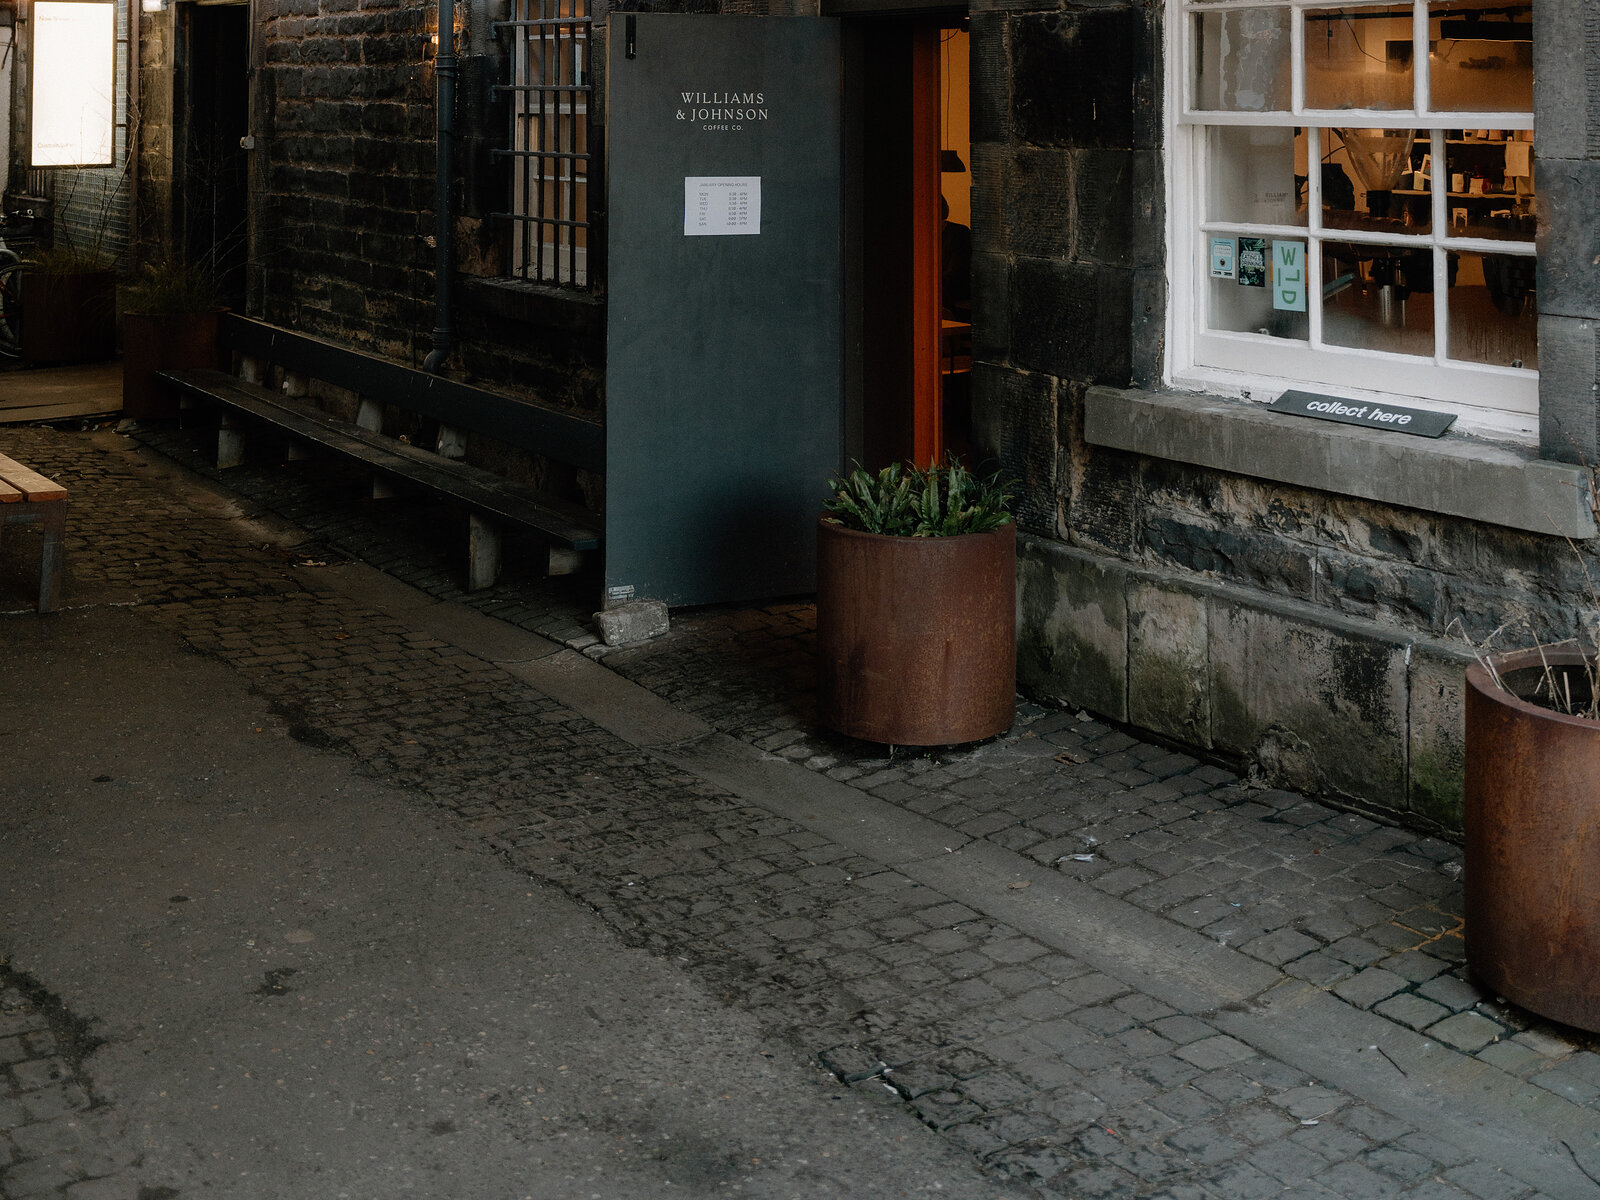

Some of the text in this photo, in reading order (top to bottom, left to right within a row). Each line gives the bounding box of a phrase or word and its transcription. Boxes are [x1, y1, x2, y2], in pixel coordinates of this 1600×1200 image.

[681, 92, 764, 104] WILLIAMS
[676, 108, 768, 121] & JOHNSON
[1278, 246, 1300, 305] WILD
[1306, 400, 1412, 425] collect here
